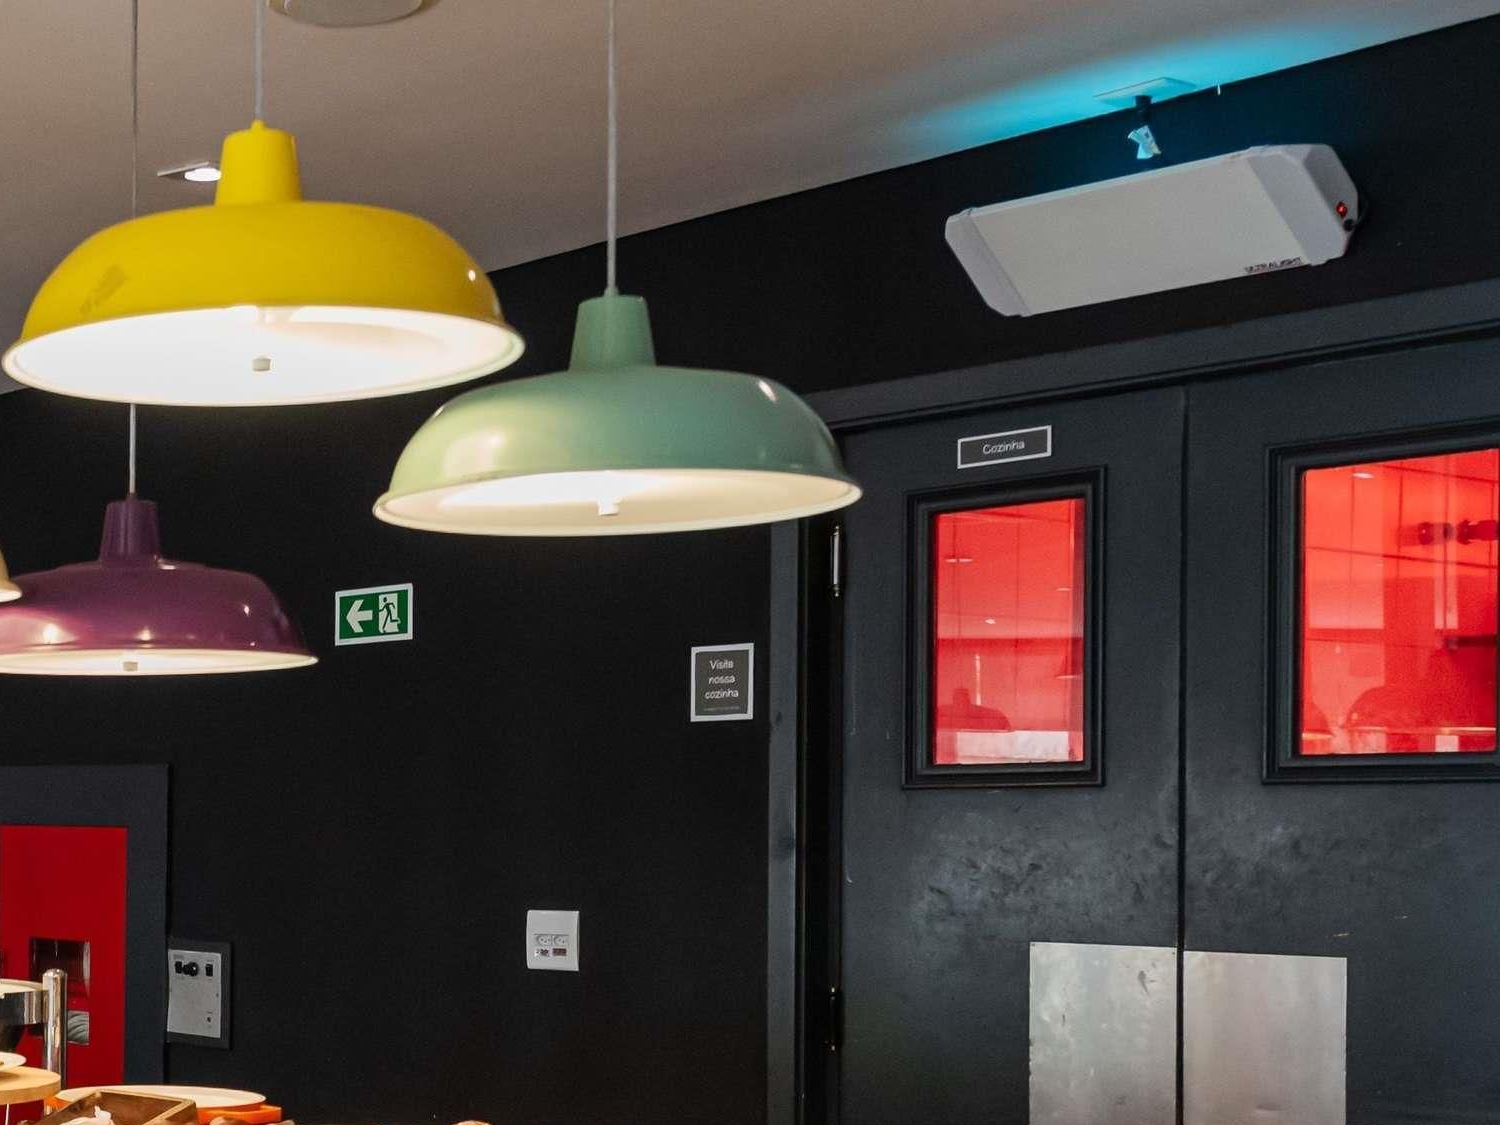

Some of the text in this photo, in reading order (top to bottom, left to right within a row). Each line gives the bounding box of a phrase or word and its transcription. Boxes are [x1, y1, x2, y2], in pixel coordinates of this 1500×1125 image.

[982, 440, 1025, 455] Cozinha
[709, 659, 734, 670] Visite
[709, 675, 735, 684] nossa
[705, 687, 739, 699] cozinha
